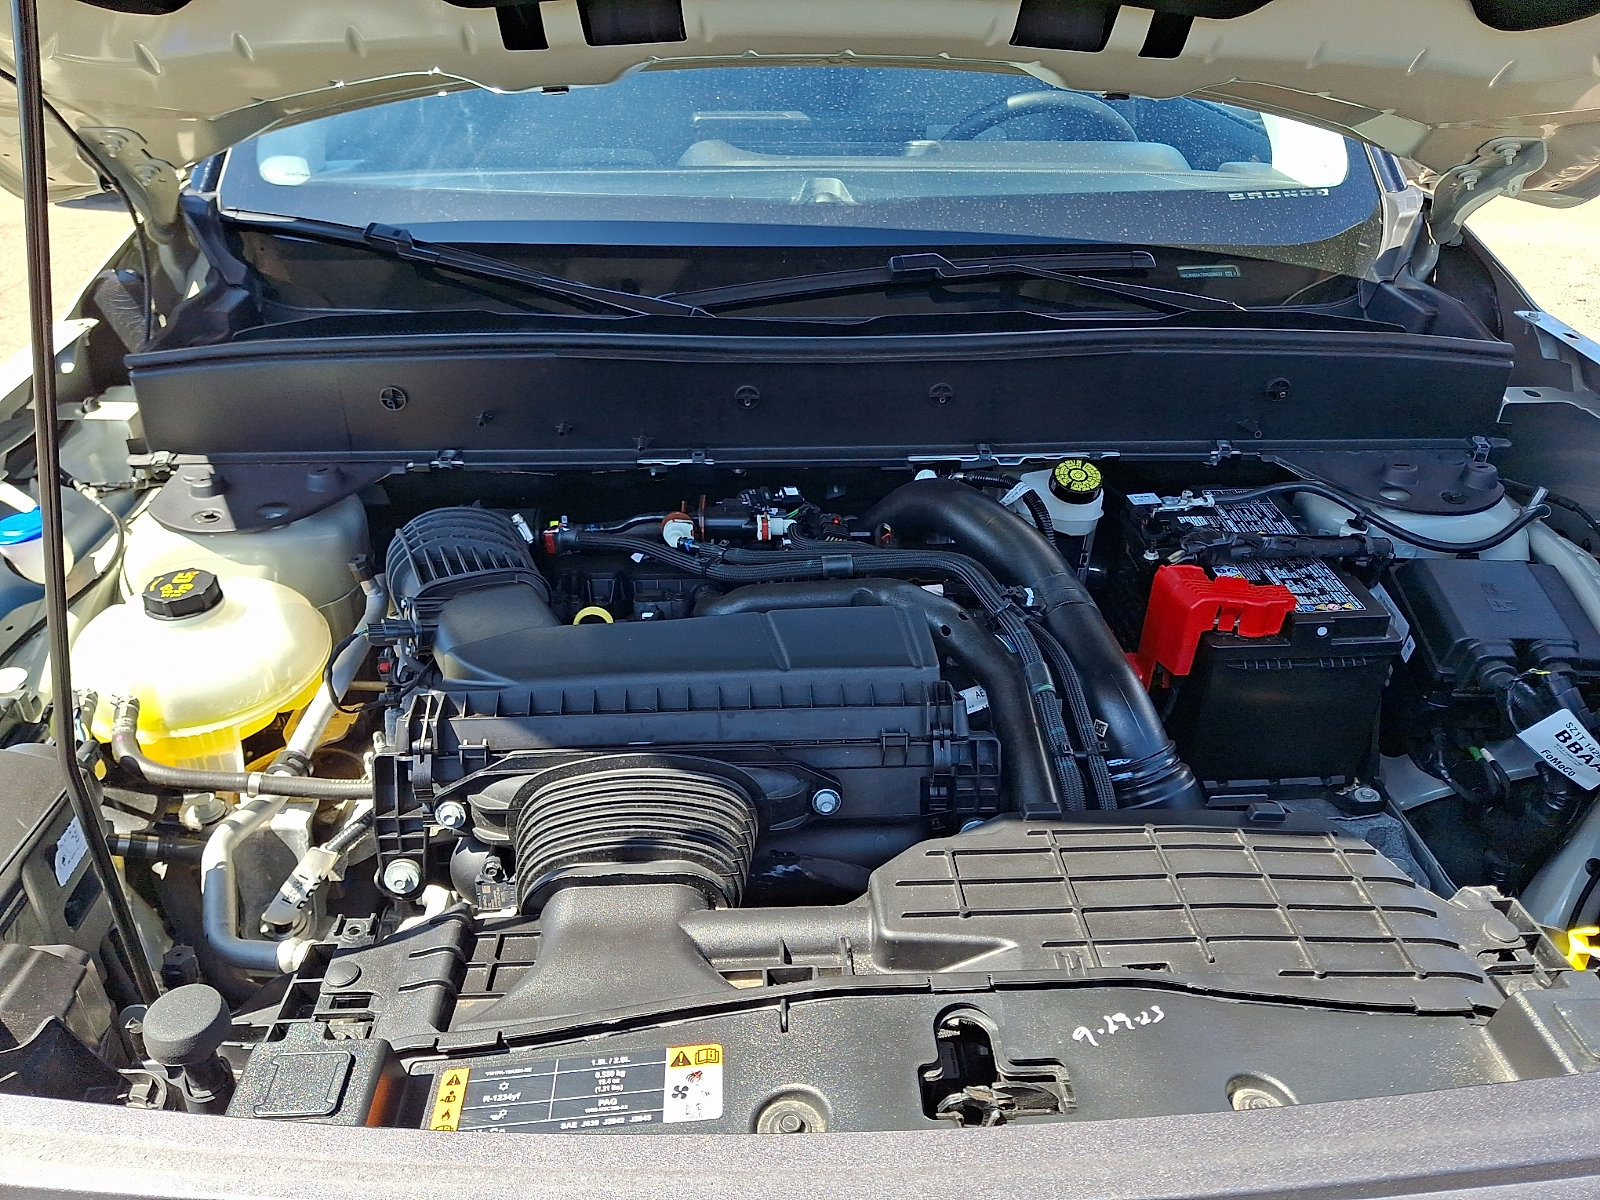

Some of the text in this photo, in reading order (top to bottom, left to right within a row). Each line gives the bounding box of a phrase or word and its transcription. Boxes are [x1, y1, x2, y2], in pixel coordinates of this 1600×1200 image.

[482, 1091, 522, 1103] R-1234yf
[597, 1097, 618, 1107] PAG
[559, 1121, 578, 1130] SAE
